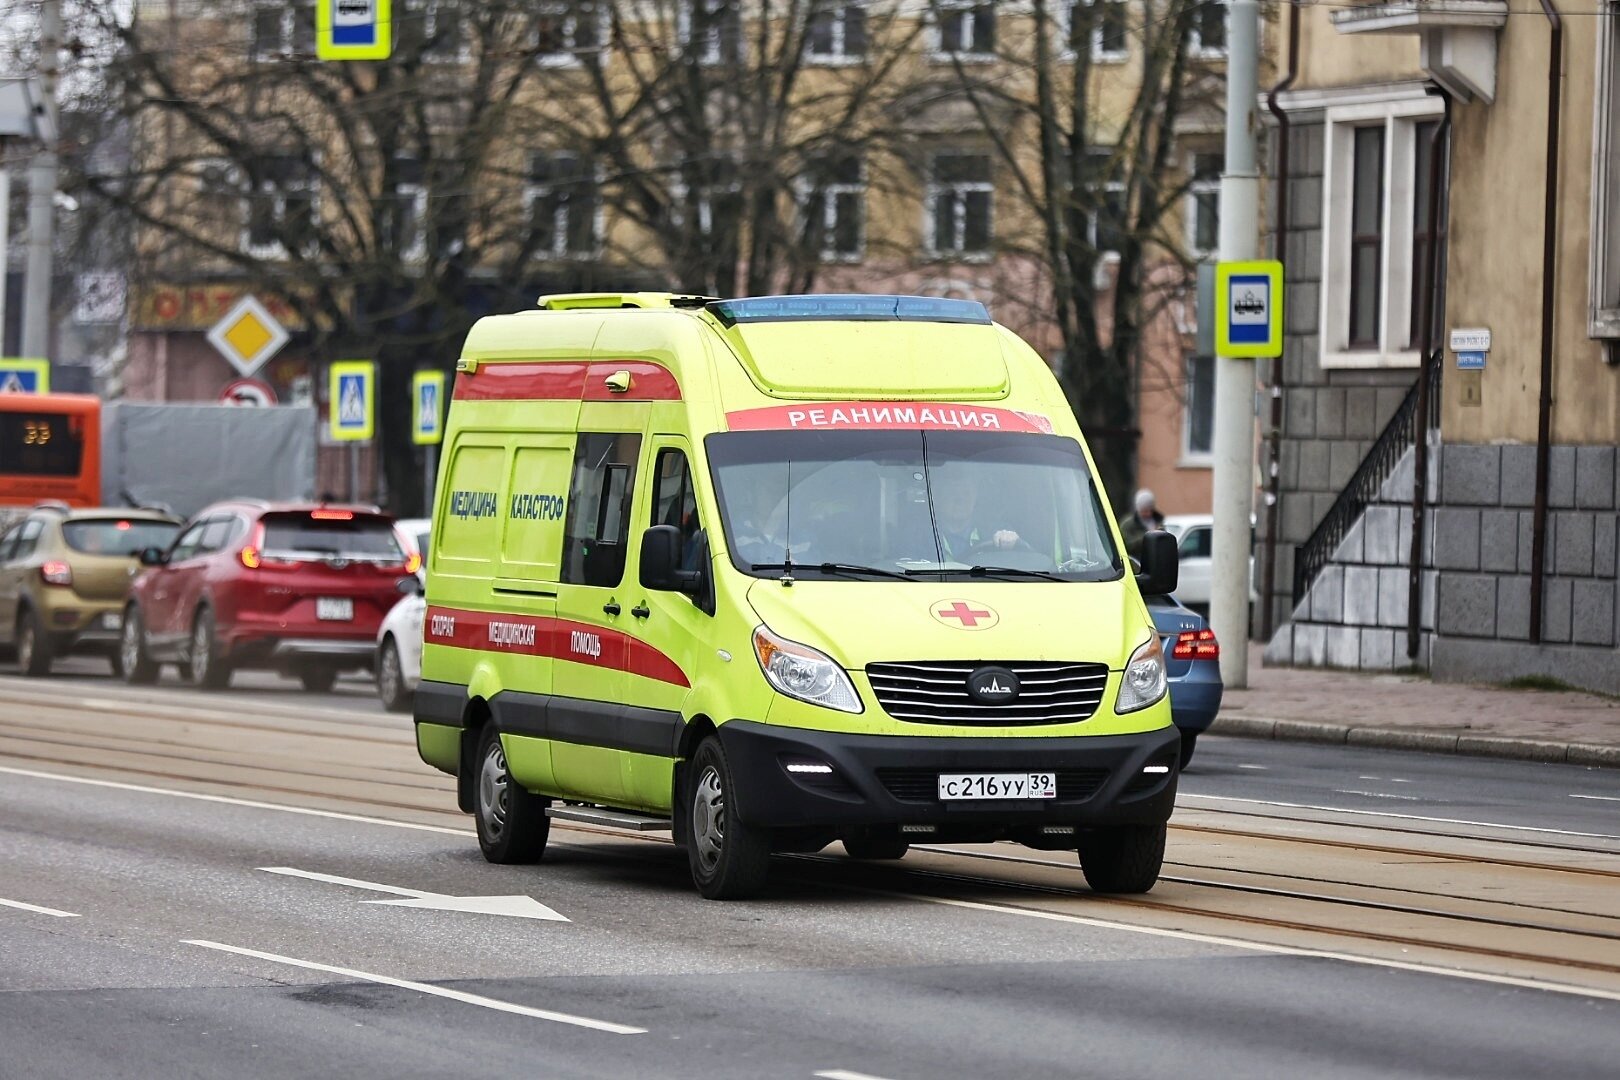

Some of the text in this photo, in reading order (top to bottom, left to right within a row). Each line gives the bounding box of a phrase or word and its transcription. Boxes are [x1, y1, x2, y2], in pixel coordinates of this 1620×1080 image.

[788, 408, 1000, 428] РЕАНИМАЦИЯ
[450, 491, 564, 521] МЕДИЦИНА КАТАСТРОФ
[431, 614, 601, 660] СКОРАЯ МЕДИЦИНСКАЯ ПОМОЩЬ
[1030, 775, 1050, 790] 39
